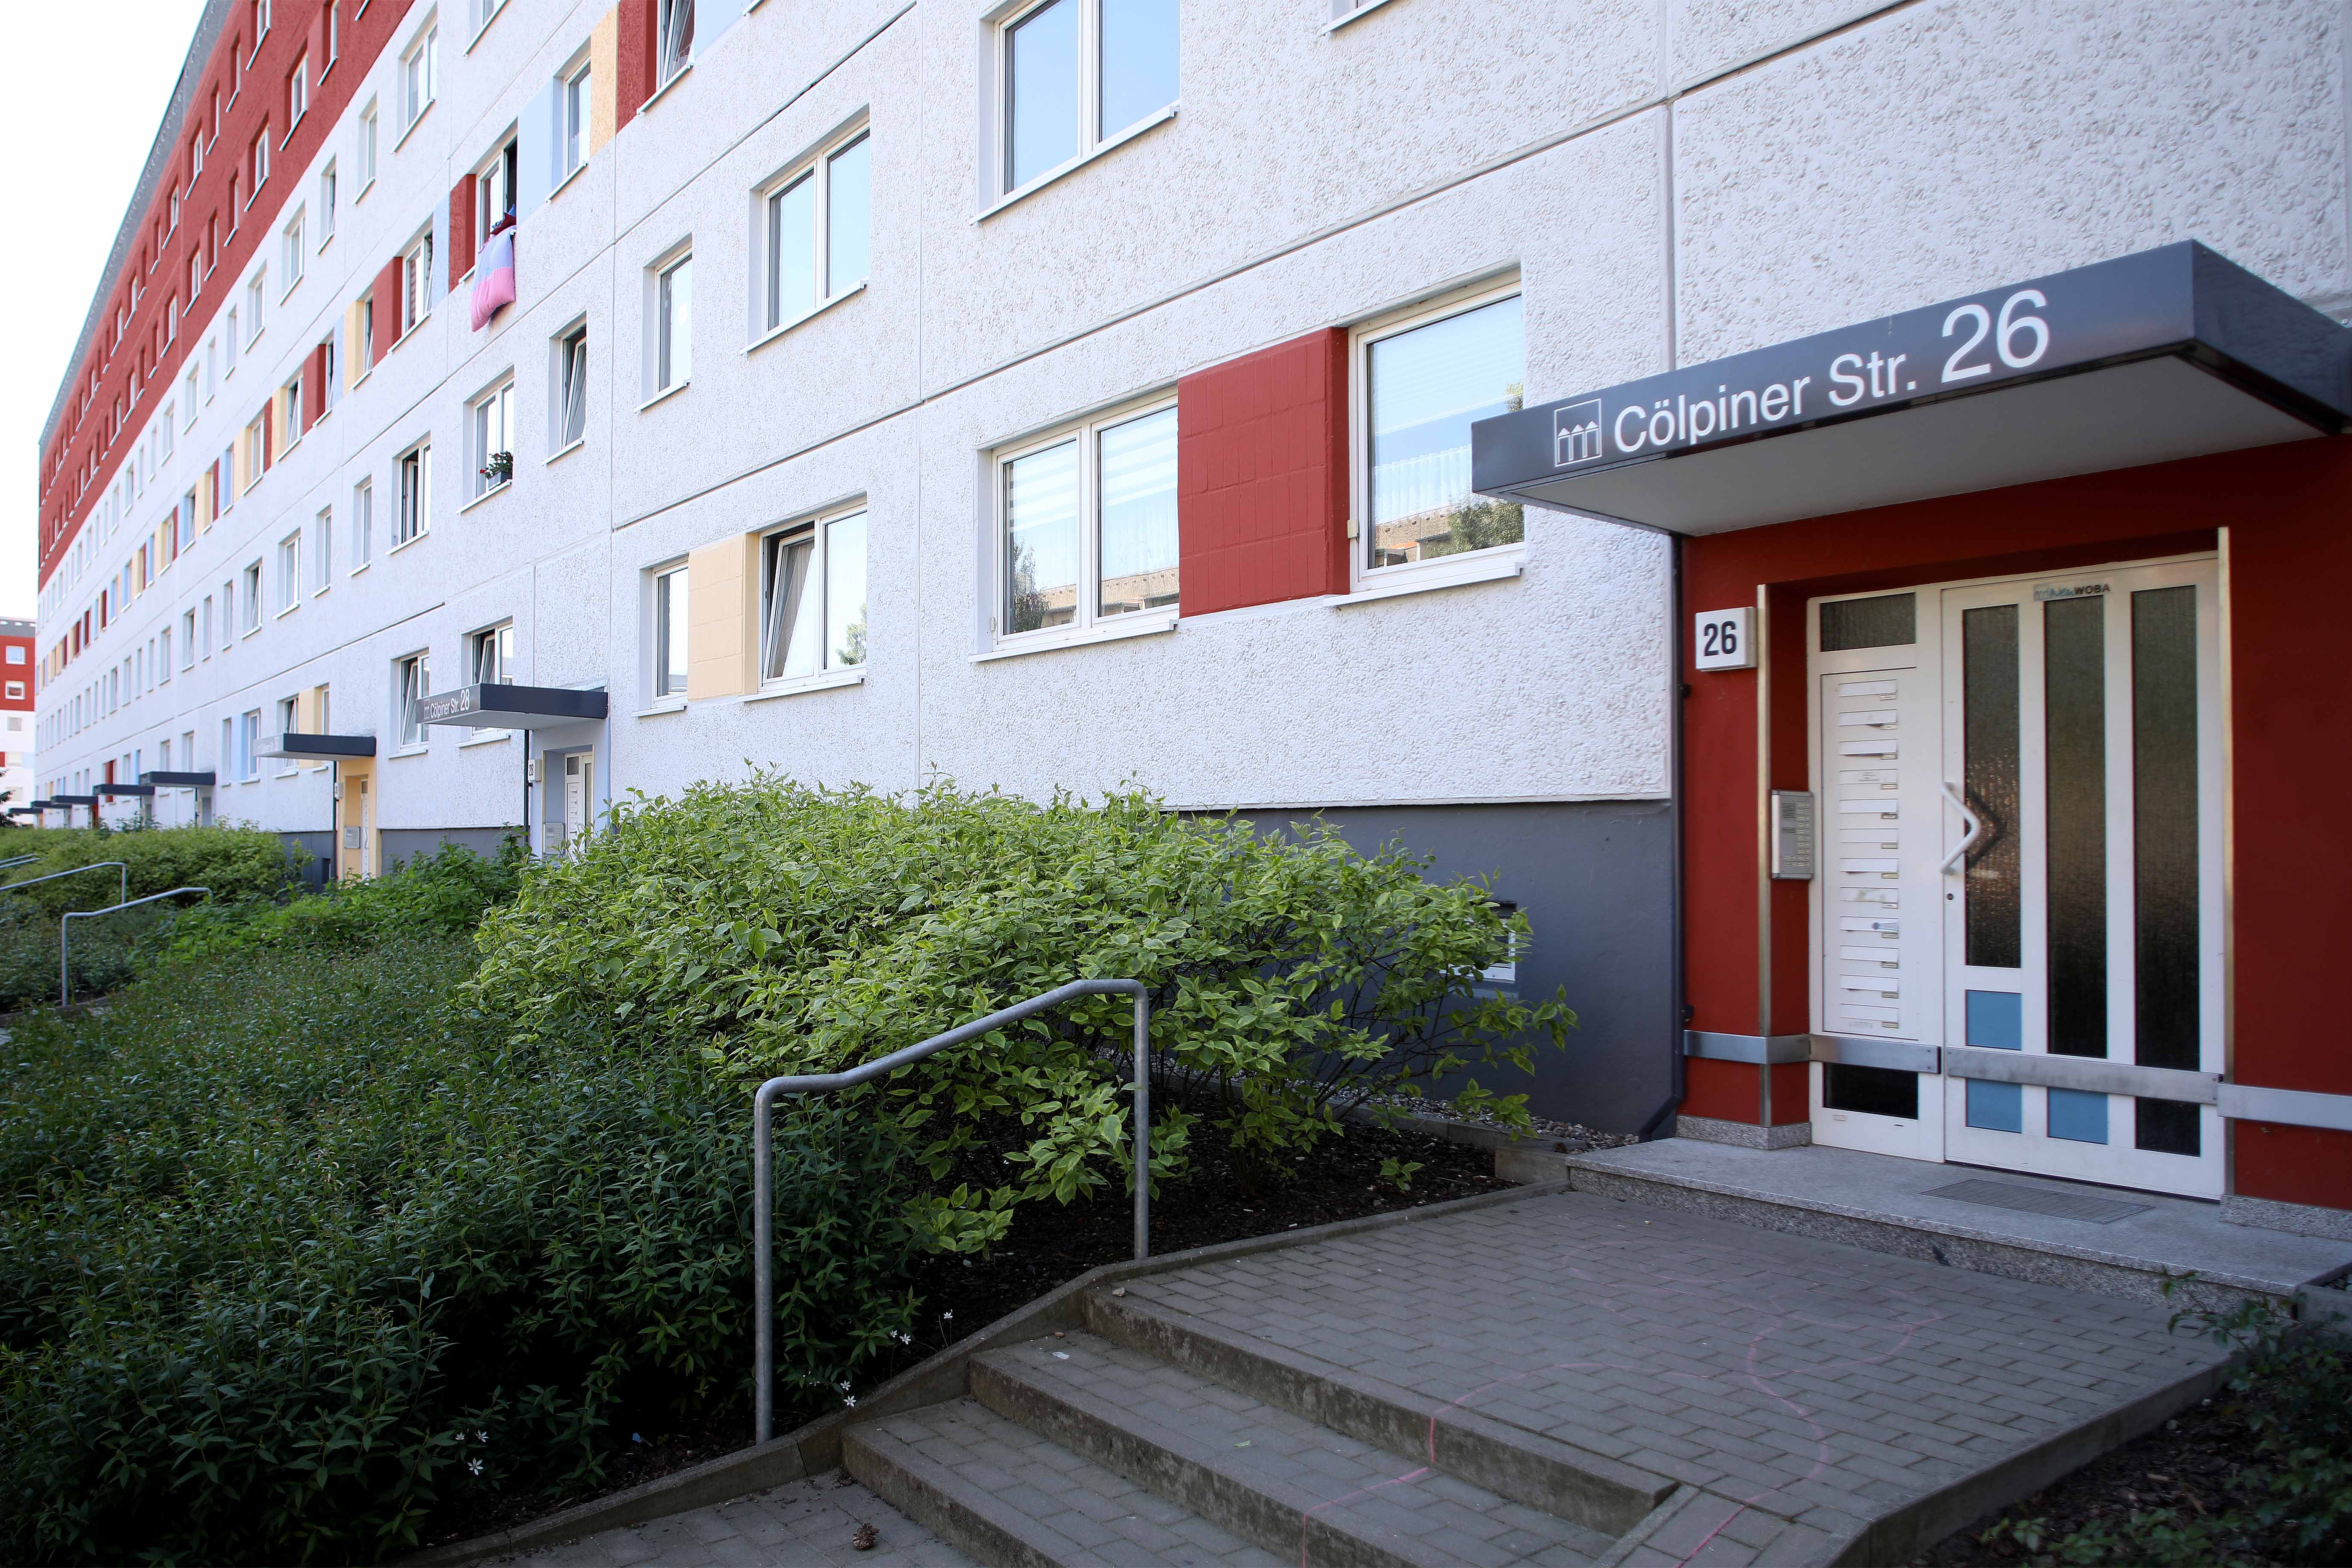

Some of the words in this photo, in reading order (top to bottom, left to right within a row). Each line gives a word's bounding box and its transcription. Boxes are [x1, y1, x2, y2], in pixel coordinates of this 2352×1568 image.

[1613, 375, 1811, 453] Cölpiner
[1828, 350, 1917, 407] Str.
[1941, 289, 2049, 384] 26
[1704, 620, 1737, 657] 26
[430, 701, 449, 718] Cölpiner
[450, 697, 459, 714] Str.
[460, 688, 470, 711] 28
[529, 764, 534, 776] 28
